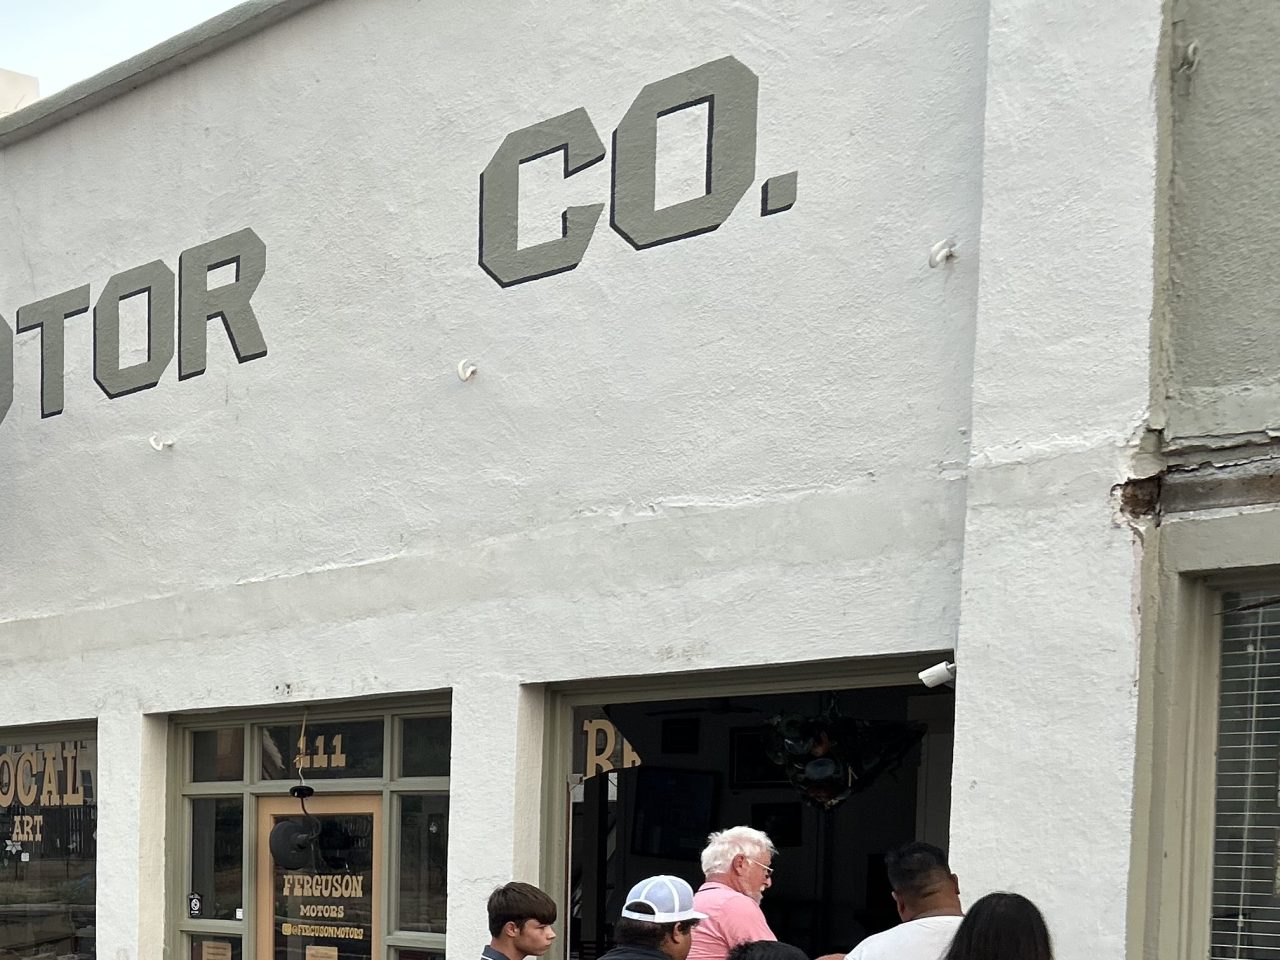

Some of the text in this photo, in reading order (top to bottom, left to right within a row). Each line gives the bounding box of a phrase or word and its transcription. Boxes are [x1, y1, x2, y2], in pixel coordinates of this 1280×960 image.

[478, 55, 798, 288] CO.
[295, 734, 346, 768] 111
[12, 815, 43, 841] ART
[283, 874, 363, 898] FERGUSON
[299, 904, 344, 918] MOTORS
[291, 924, 364, 940] @FERGUSONMOTORS
